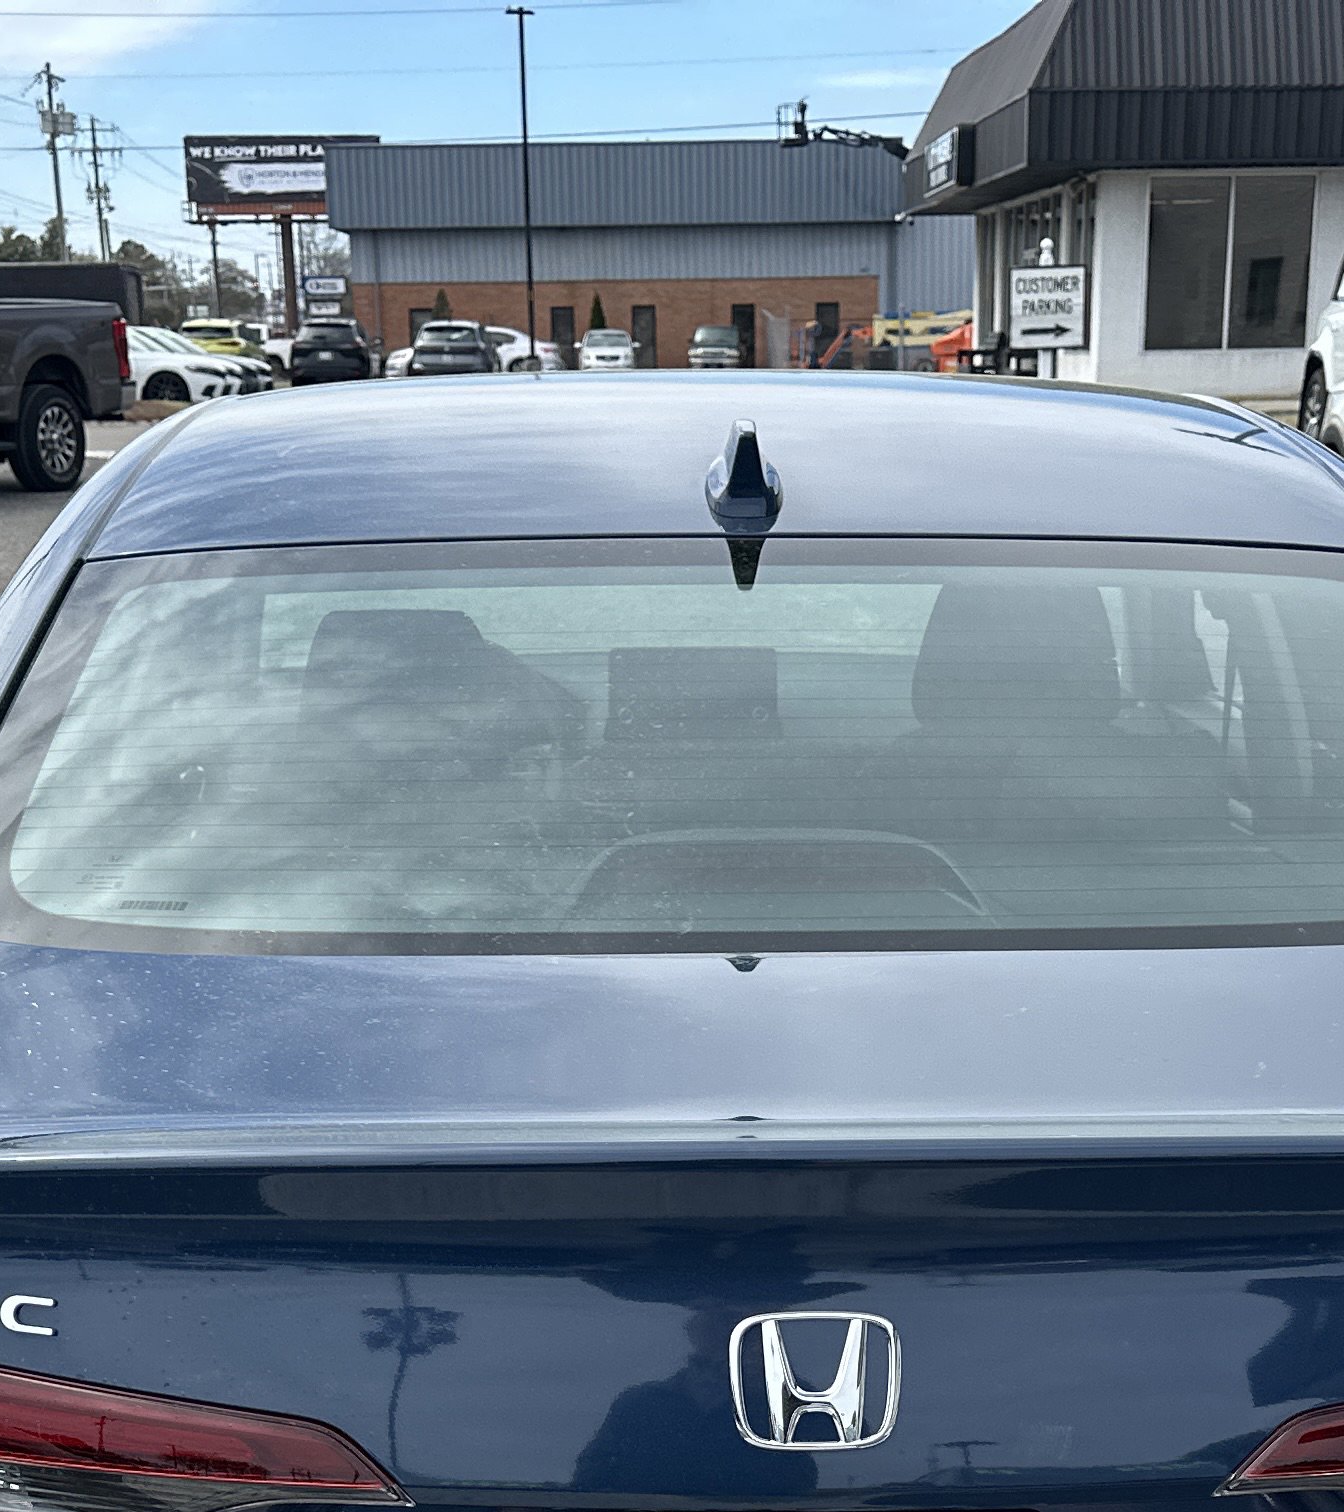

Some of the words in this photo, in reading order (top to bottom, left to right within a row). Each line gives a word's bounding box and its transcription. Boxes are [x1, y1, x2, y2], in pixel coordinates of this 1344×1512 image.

[190, 145, 212, 158] WE
[214, 145, 256, 158] KNOW
[1016, 276, 1080, 294] CUSTOMER
[1022, 298, 1074, 316] PARKING
